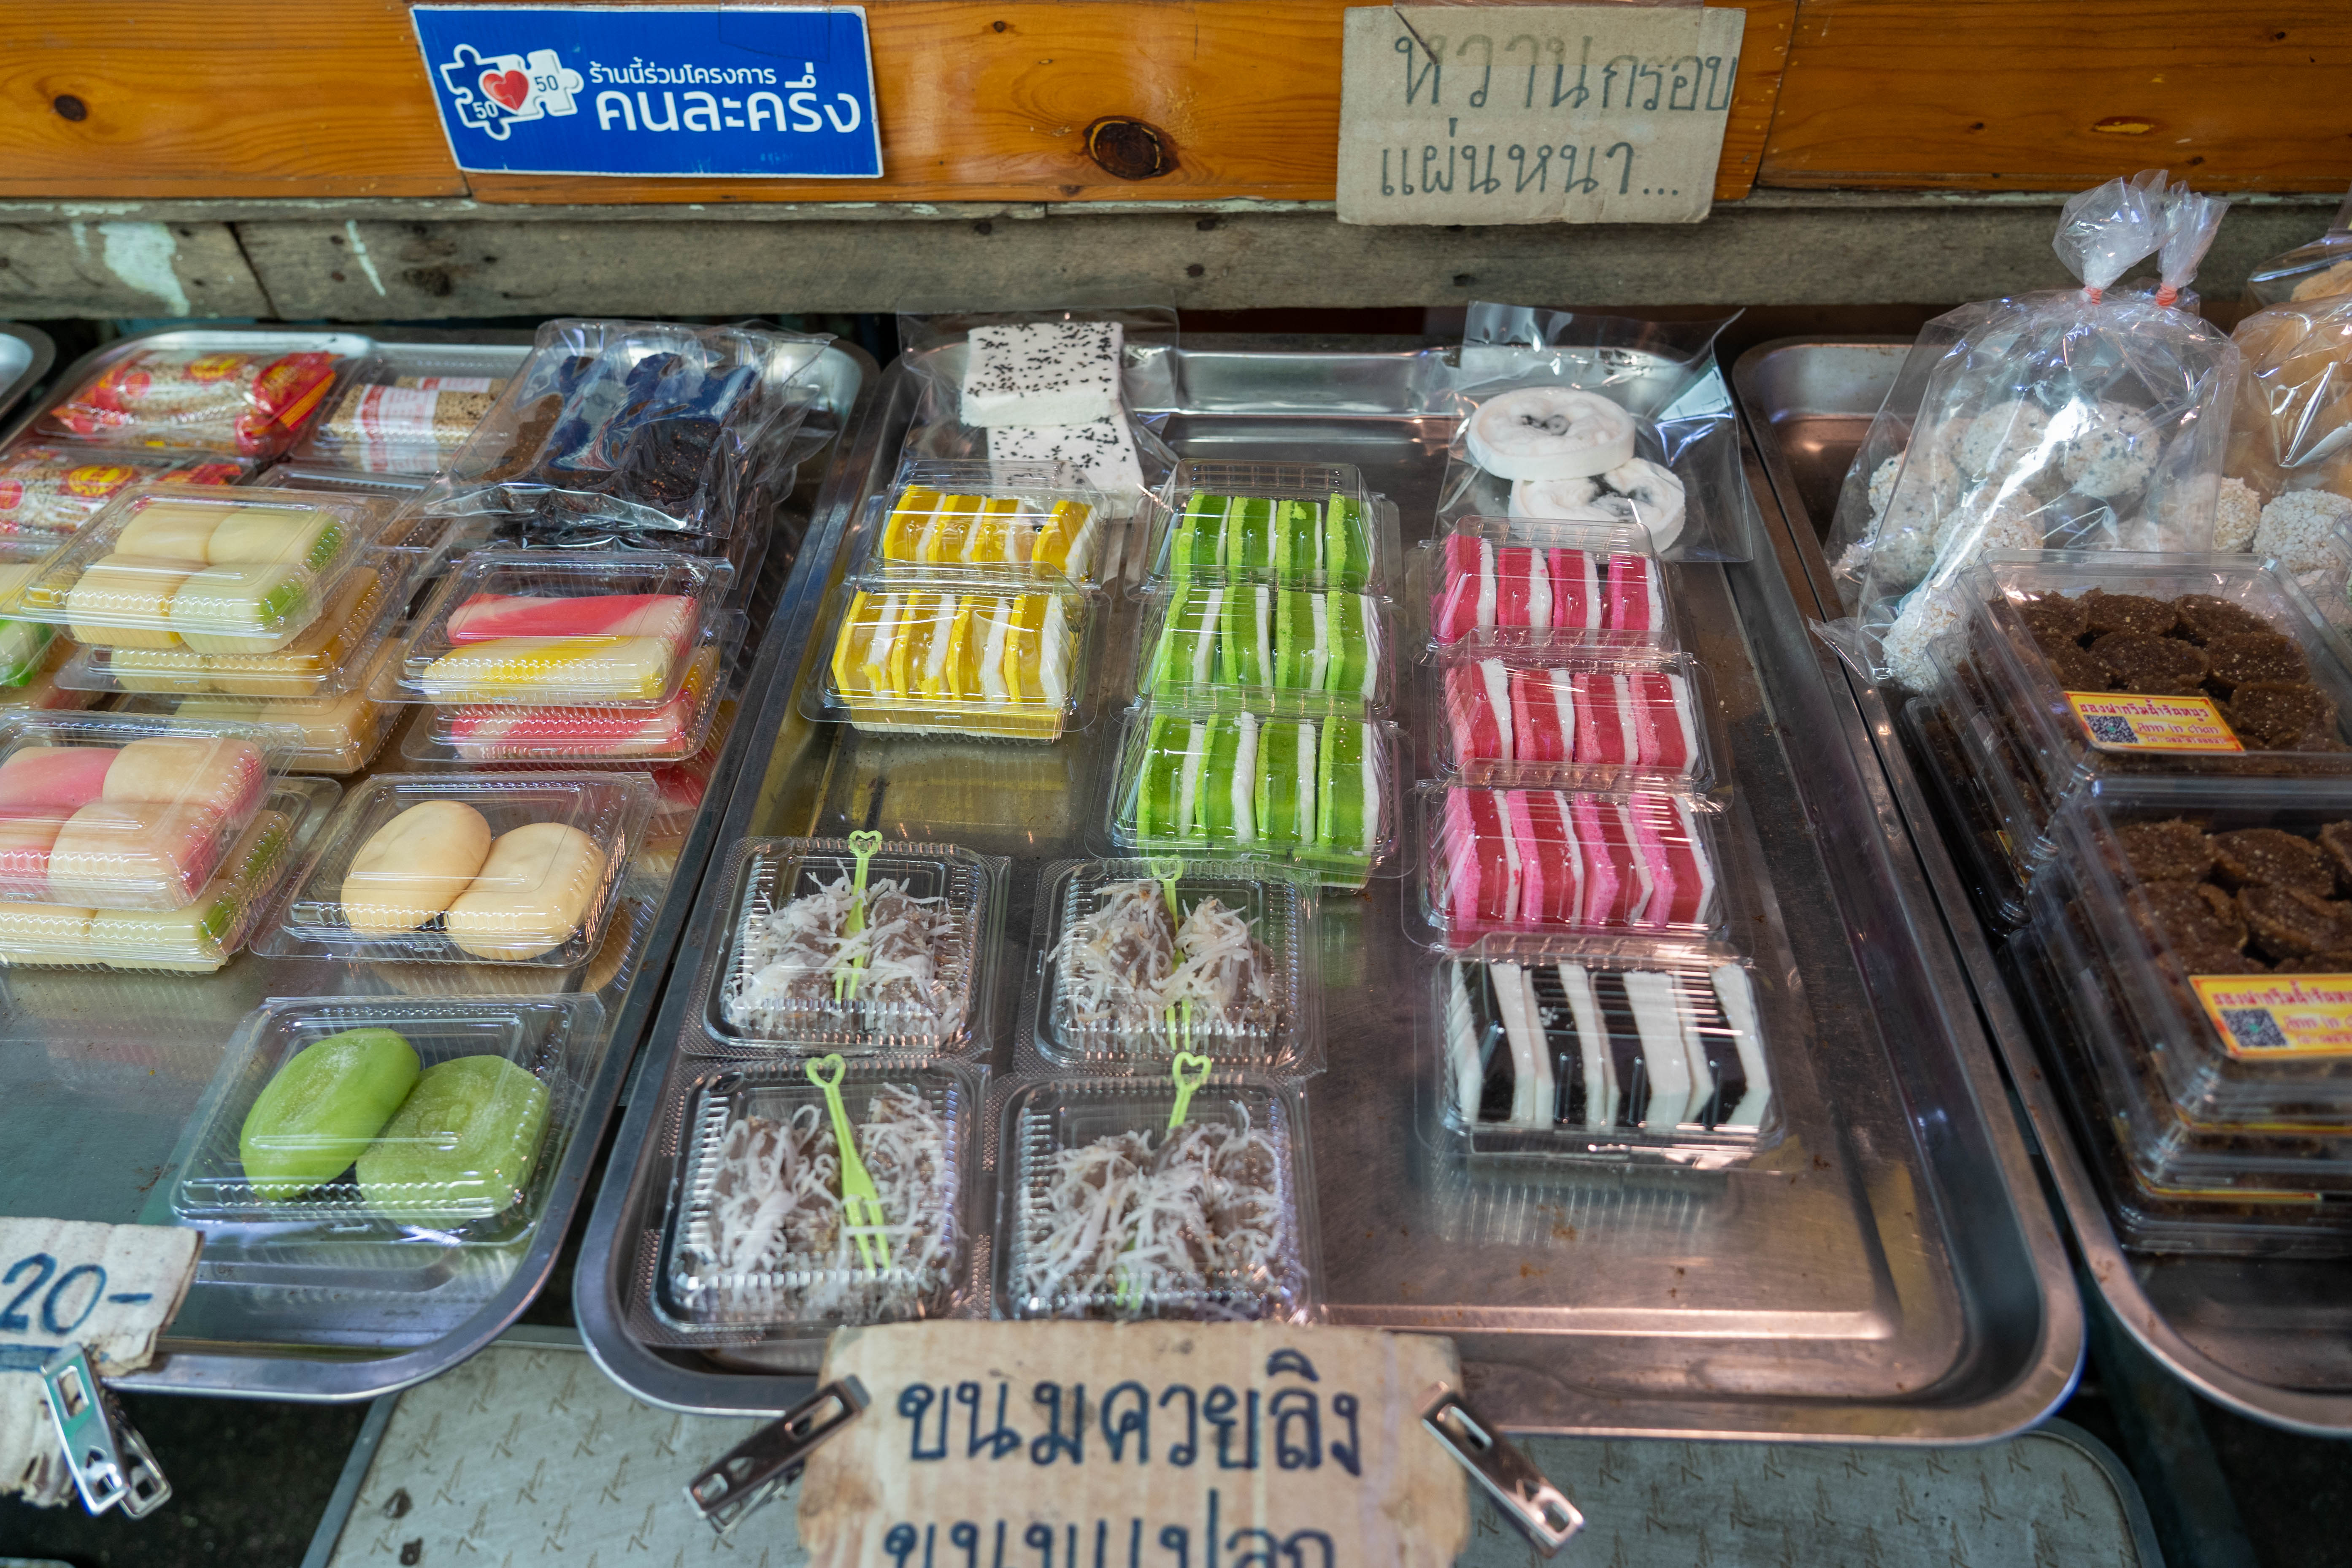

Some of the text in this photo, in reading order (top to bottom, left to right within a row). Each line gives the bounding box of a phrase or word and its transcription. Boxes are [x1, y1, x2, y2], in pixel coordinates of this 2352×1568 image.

[590, 57, 777, 84] ร้านนี้ร่วมโครงการ
[535, 75, 558, 92] 50
[596, 62, 861, 133] คนละครึ่ง
[472, 101, 498, 119] 50
[2137, 722, 2165, 732] Ann
[898, 1349, 1361, 1477] ขนมควยลิง
